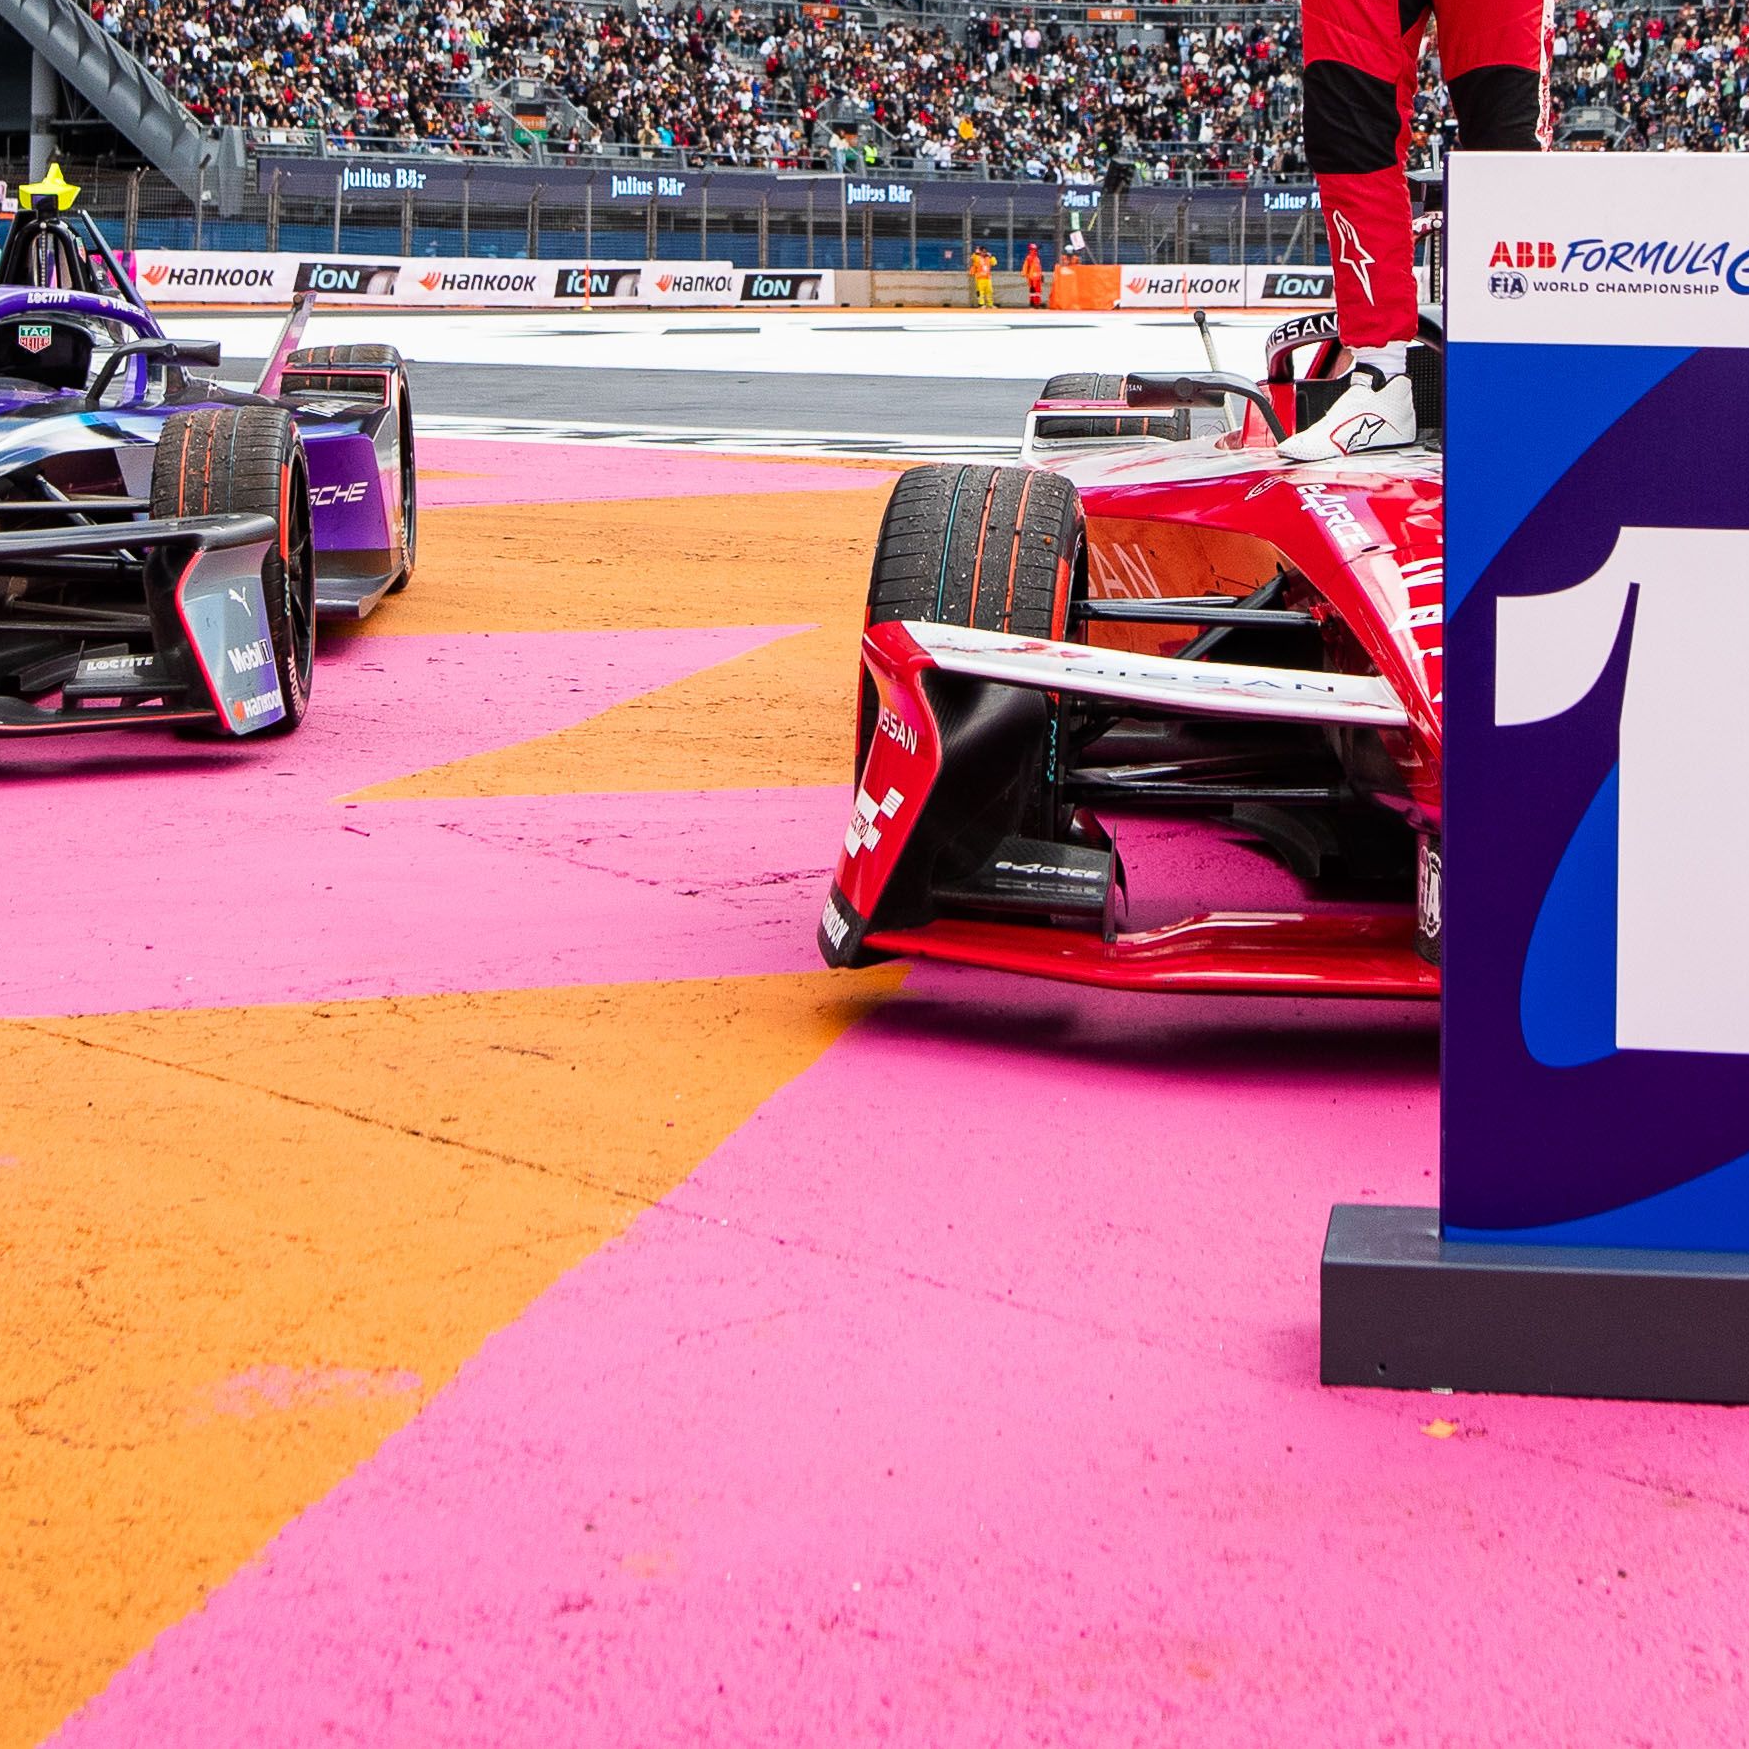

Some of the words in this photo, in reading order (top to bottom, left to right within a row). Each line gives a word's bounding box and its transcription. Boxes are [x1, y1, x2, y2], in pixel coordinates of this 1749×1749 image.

[343, 166, 392, 191] Julius
[395, 167, 427, 190] Bär
[611, 174, 654, 198] Julius
[657, 176, 686, 197] Bär
[888, 184, 913, 204] Bär
[1488, 241, 1557, 268] ABB
[1561, 239, 1730, 276] FORMULA
[1489, 276, 1526, 295] FIA
[1533, 281, 1589, 293] WORLD
[1596, 282, 1720, 295] CHAMPIONSHIP
[27, 291, 71, 304] LOCTITE
[21, 327, 50, 336] TAG
[20, 337, 51, 347] HEUER
[86, 655, 154, 672] LOCTITE
[227, 643, 263, 674] Mobil
